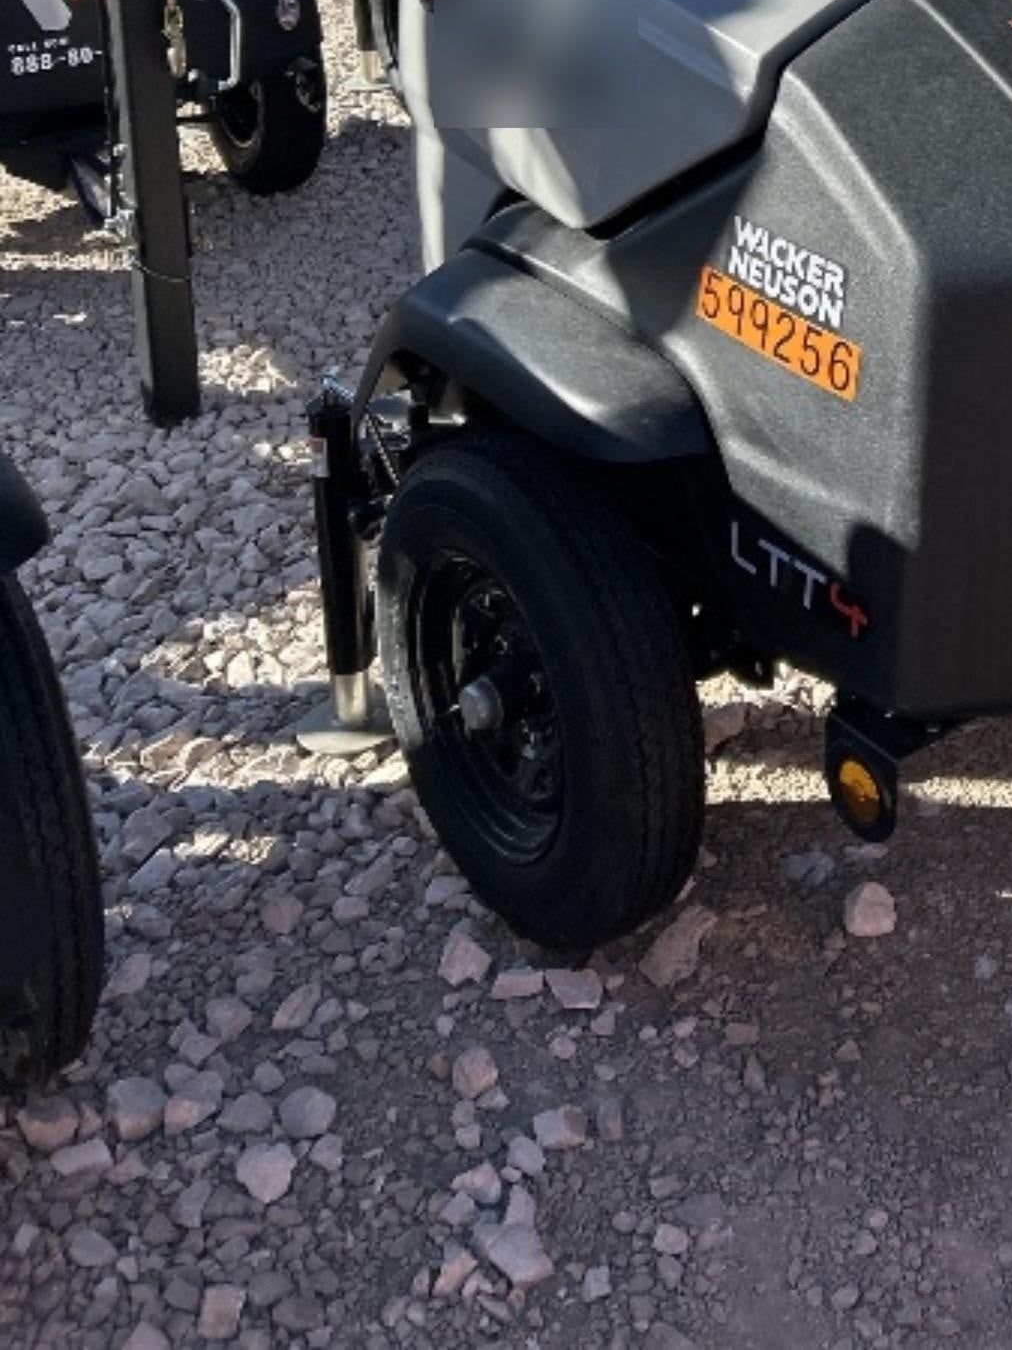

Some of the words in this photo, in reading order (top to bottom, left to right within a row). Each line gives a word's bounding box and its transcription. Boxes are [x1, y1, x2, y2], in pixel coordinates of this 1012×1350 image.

[728, 244, 844, 328] NEUSON
[733, 214, 846, 298] WACKER
[700, 267, 855, 392] 599256
[730, 519, 870, 638] LTT4
